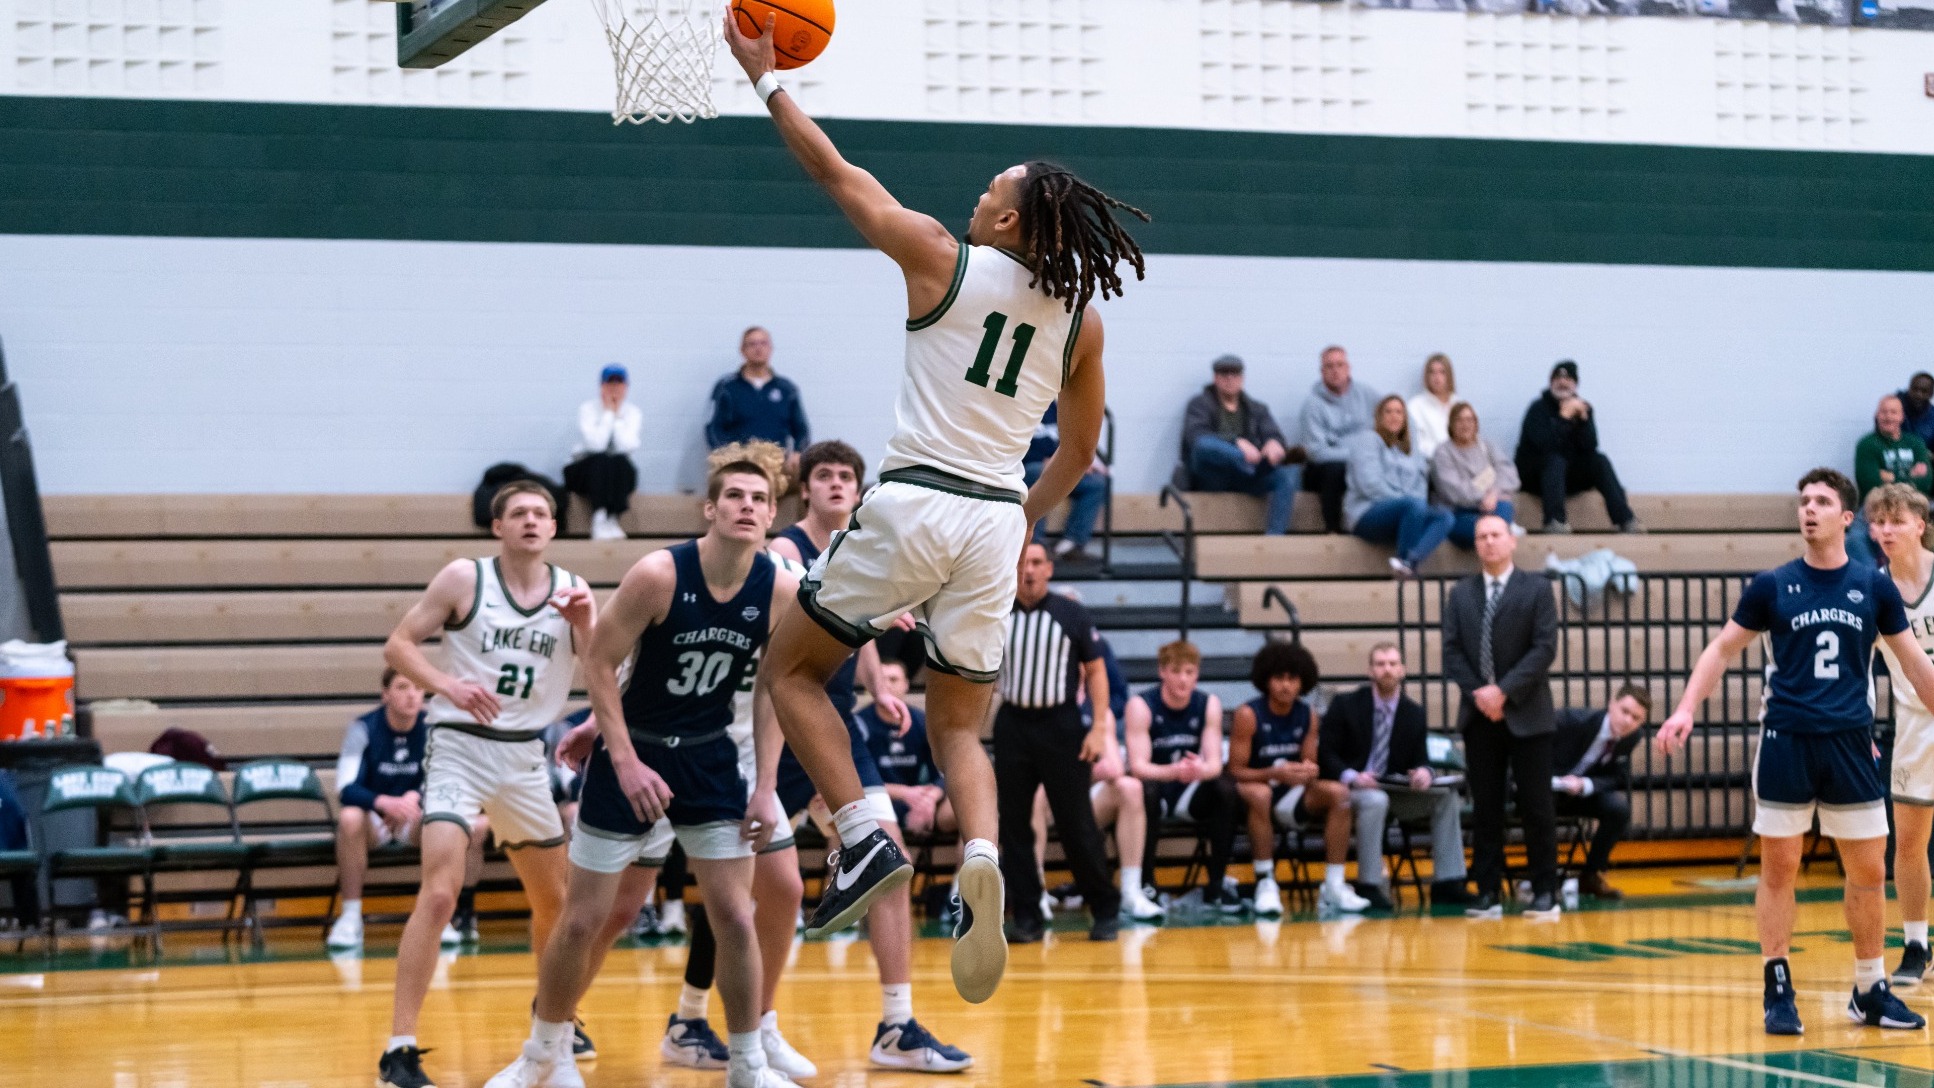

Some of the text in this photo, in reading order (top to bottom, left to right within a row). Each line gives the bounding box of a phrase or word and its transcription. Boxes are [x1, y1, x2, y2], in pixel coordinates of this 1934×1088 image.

[964, 310, 1036, 398] 11
[672, 627, 752, 650] CHARGERS
[1791, 607, 1863, 632] CHARGERS
[481, 627, 526, 654] LAKE
[1814, 630, 1840, 680] 2
[495, 662, 535, 700] 21
[666, 650, 734, 696] 30
